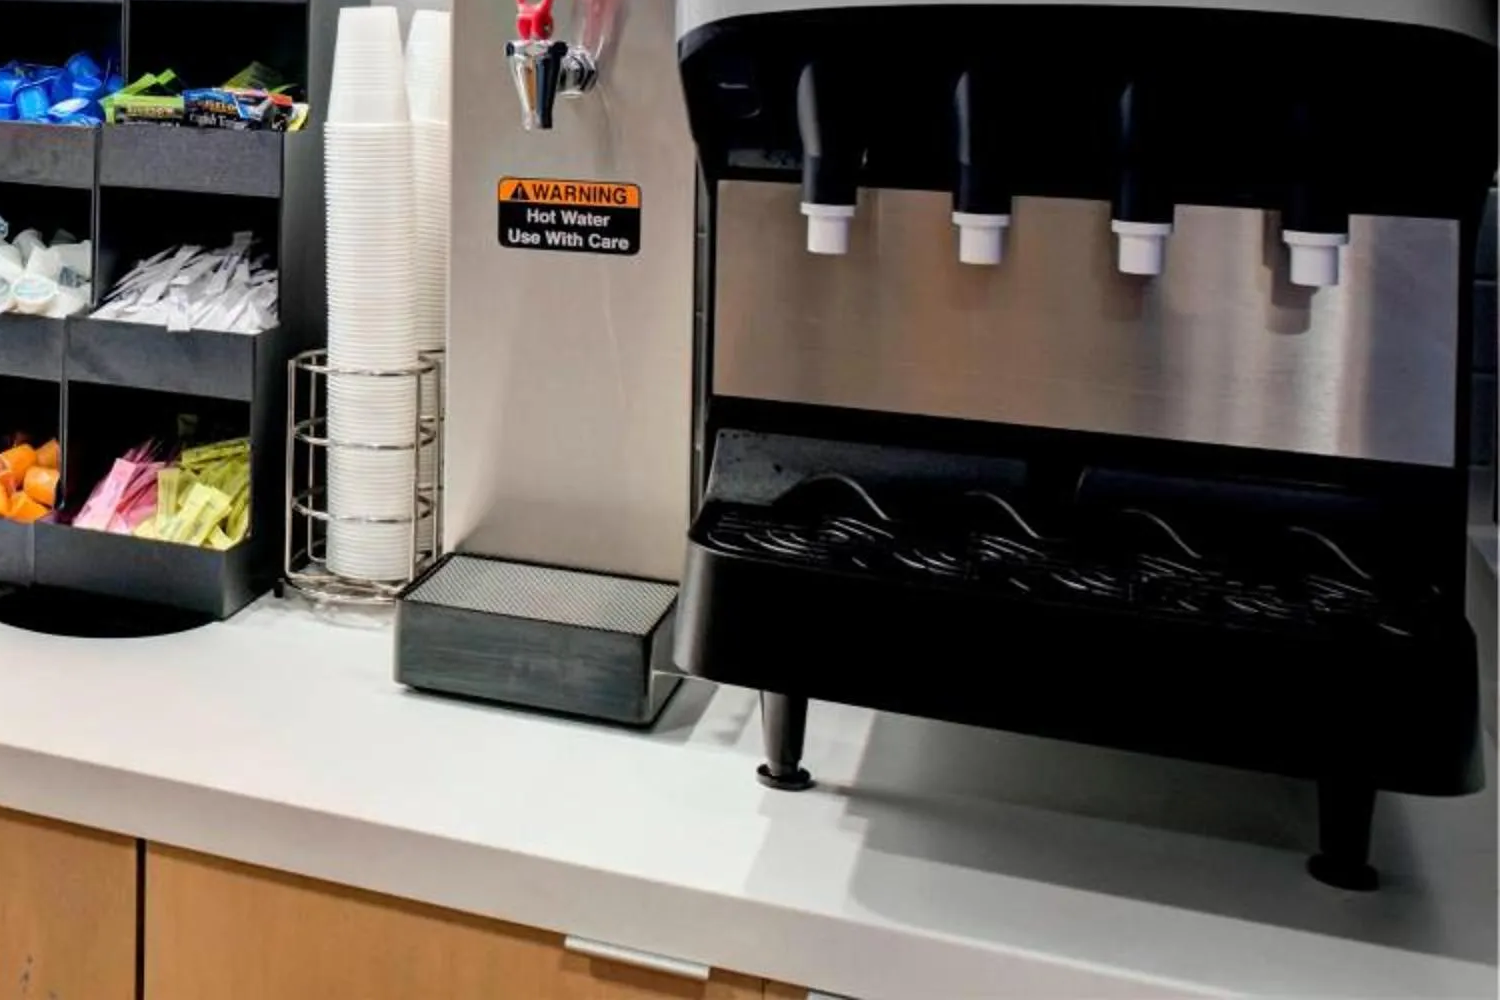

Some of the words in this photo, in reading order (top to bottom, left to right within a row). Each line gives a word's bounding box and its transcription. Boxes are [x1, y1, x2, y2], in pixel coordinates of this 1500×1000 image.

[531, 184, 627, 205] WARNING
[527, 208, 556, 224] Hot
[560, 209, 611, 227] Water
[508, 228, 541, 244] Use
[545, 230, 583, 247] With
[588, 233, 630, 250] Care
